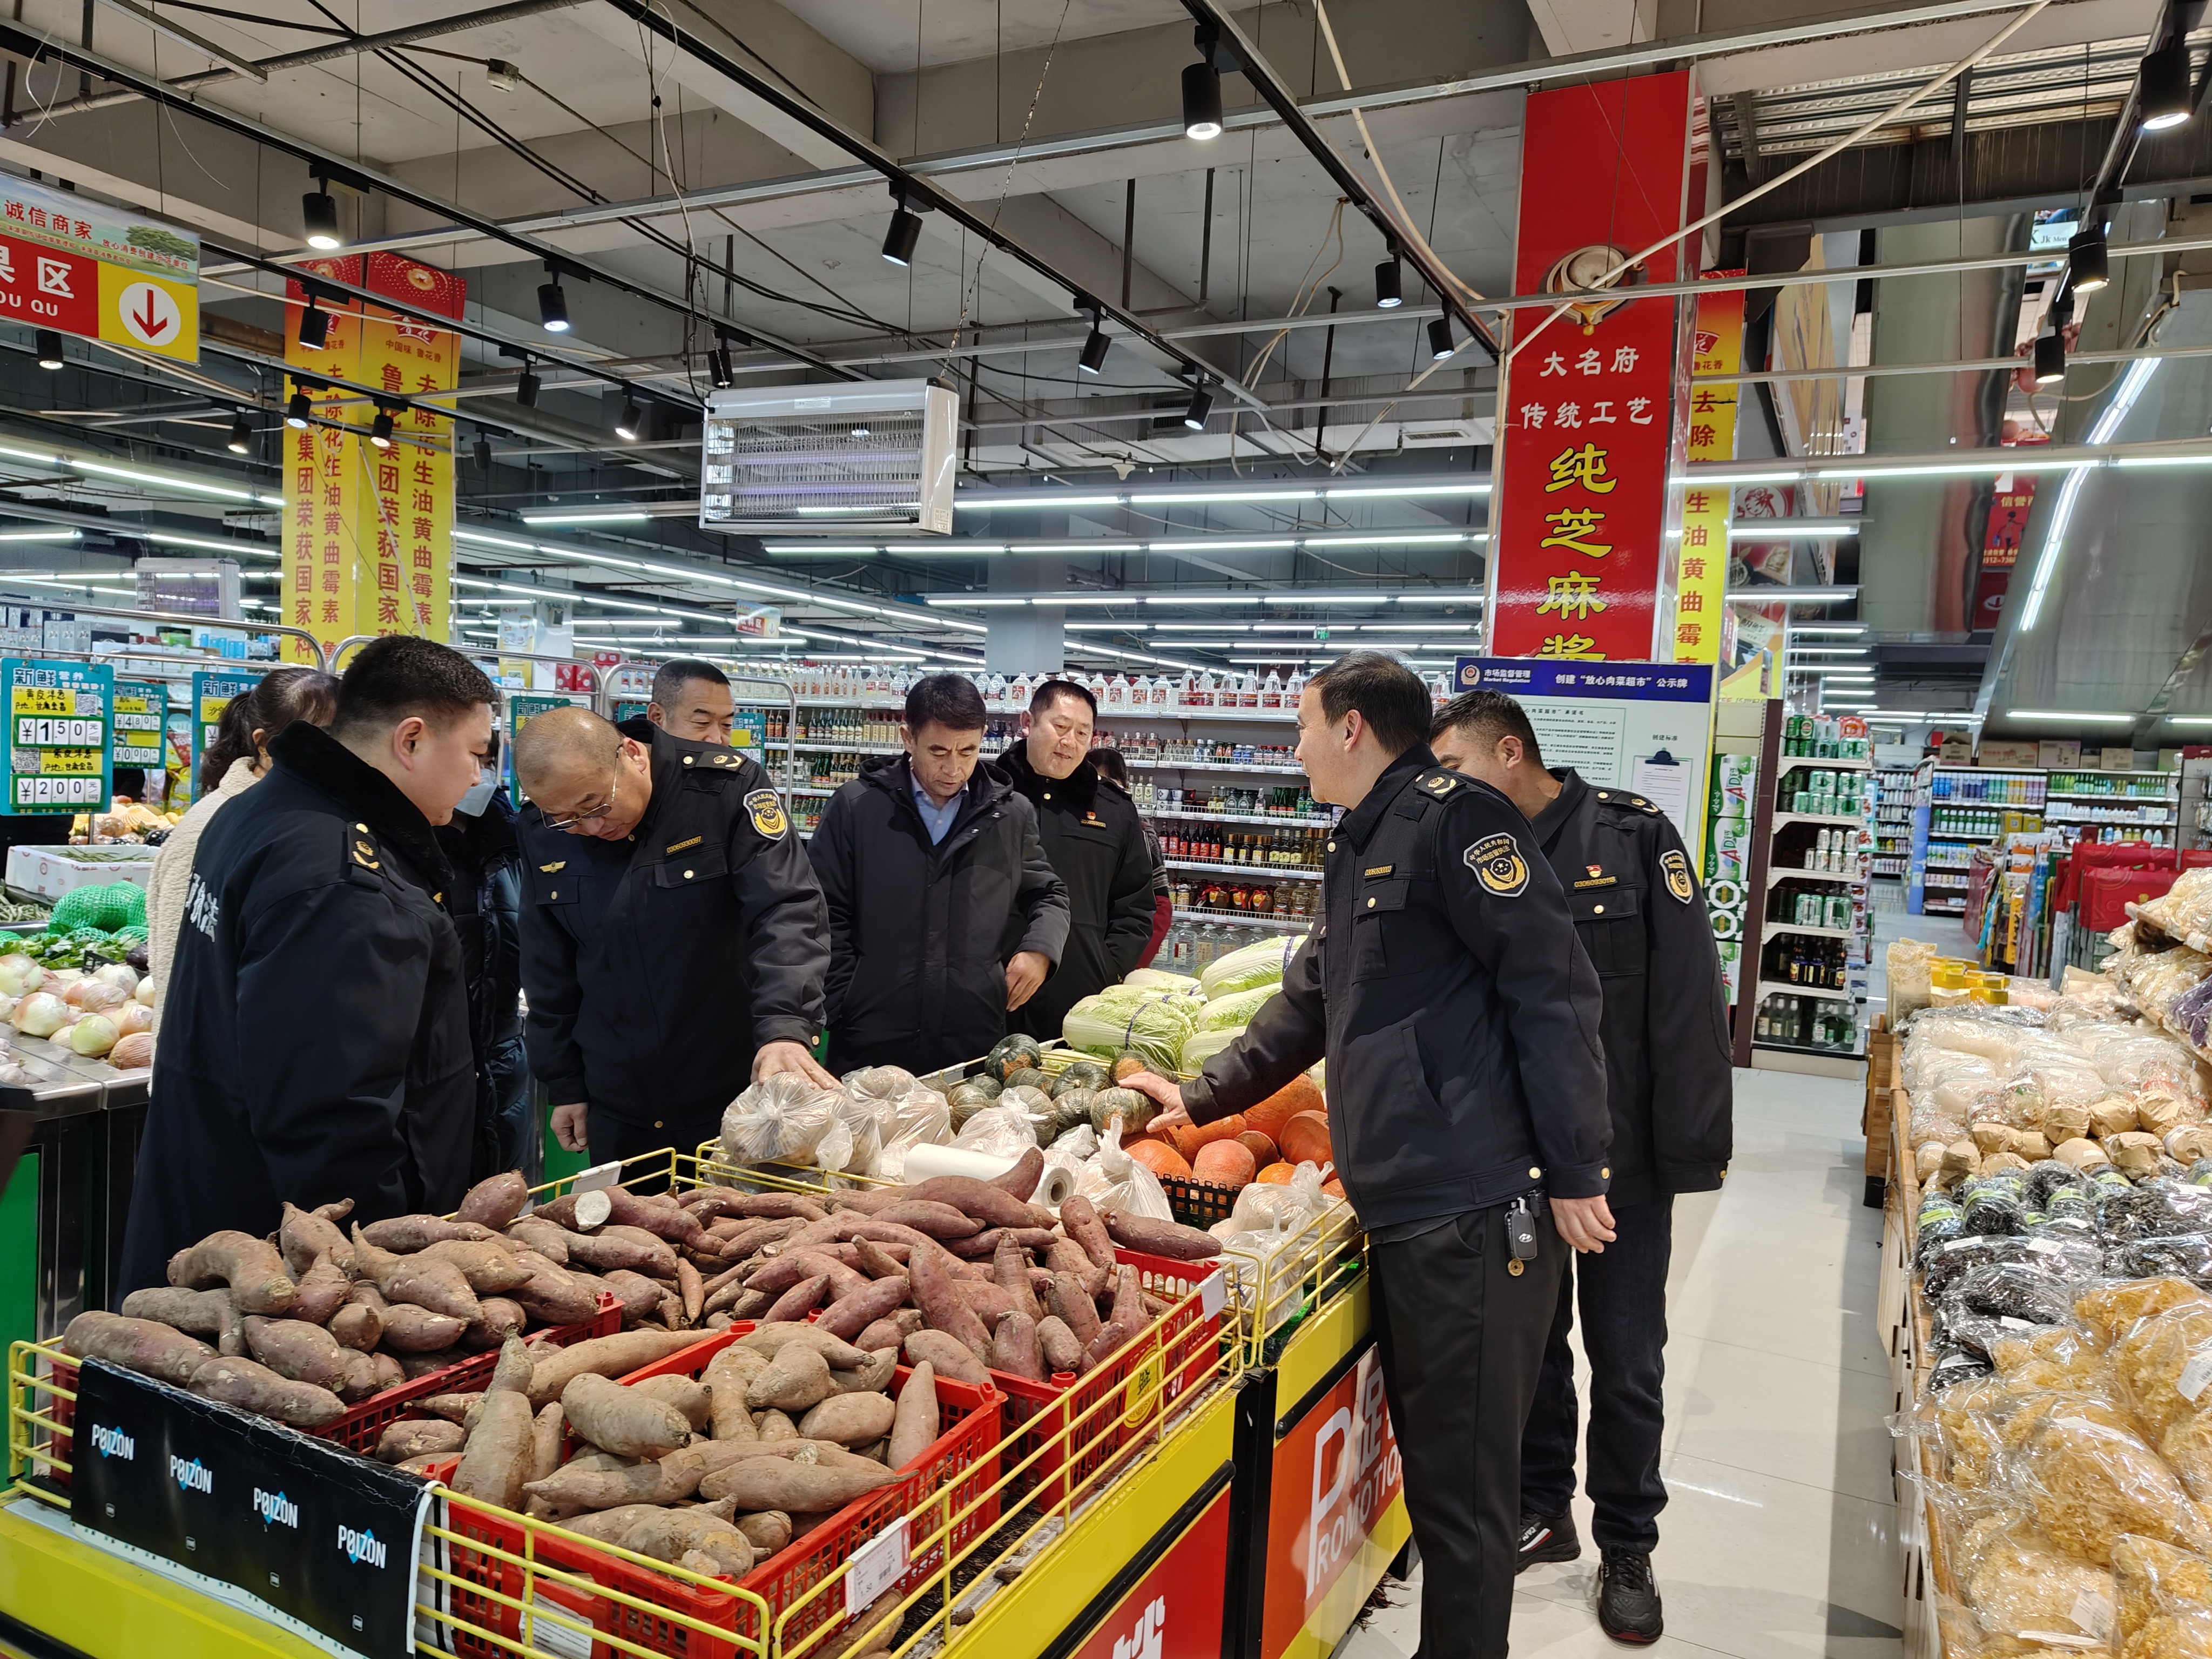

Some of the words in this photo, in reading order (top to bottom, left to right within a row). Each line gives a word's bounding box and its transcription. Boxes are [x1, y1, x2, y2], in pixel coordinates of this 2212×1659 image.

[4, 199, 93, 240] 诚信商家
[31, 299, 58, 316] QU
[1540, 345, 1640, 377] 大名府
[1519, 397, 1654, 429] 传统工艺
[1676, 390, 1716, 664] 去除生油黄曲霉
[13, 668, 56, 686] 新鲜
[1483, 669, 1531, 679] 市场监督管理
[202, 679, 238, 697] 新鲜
[1469, 838, 1510, 861] 中华人民共和国
[1475, 845, 1511, 864] 市场监督执法
